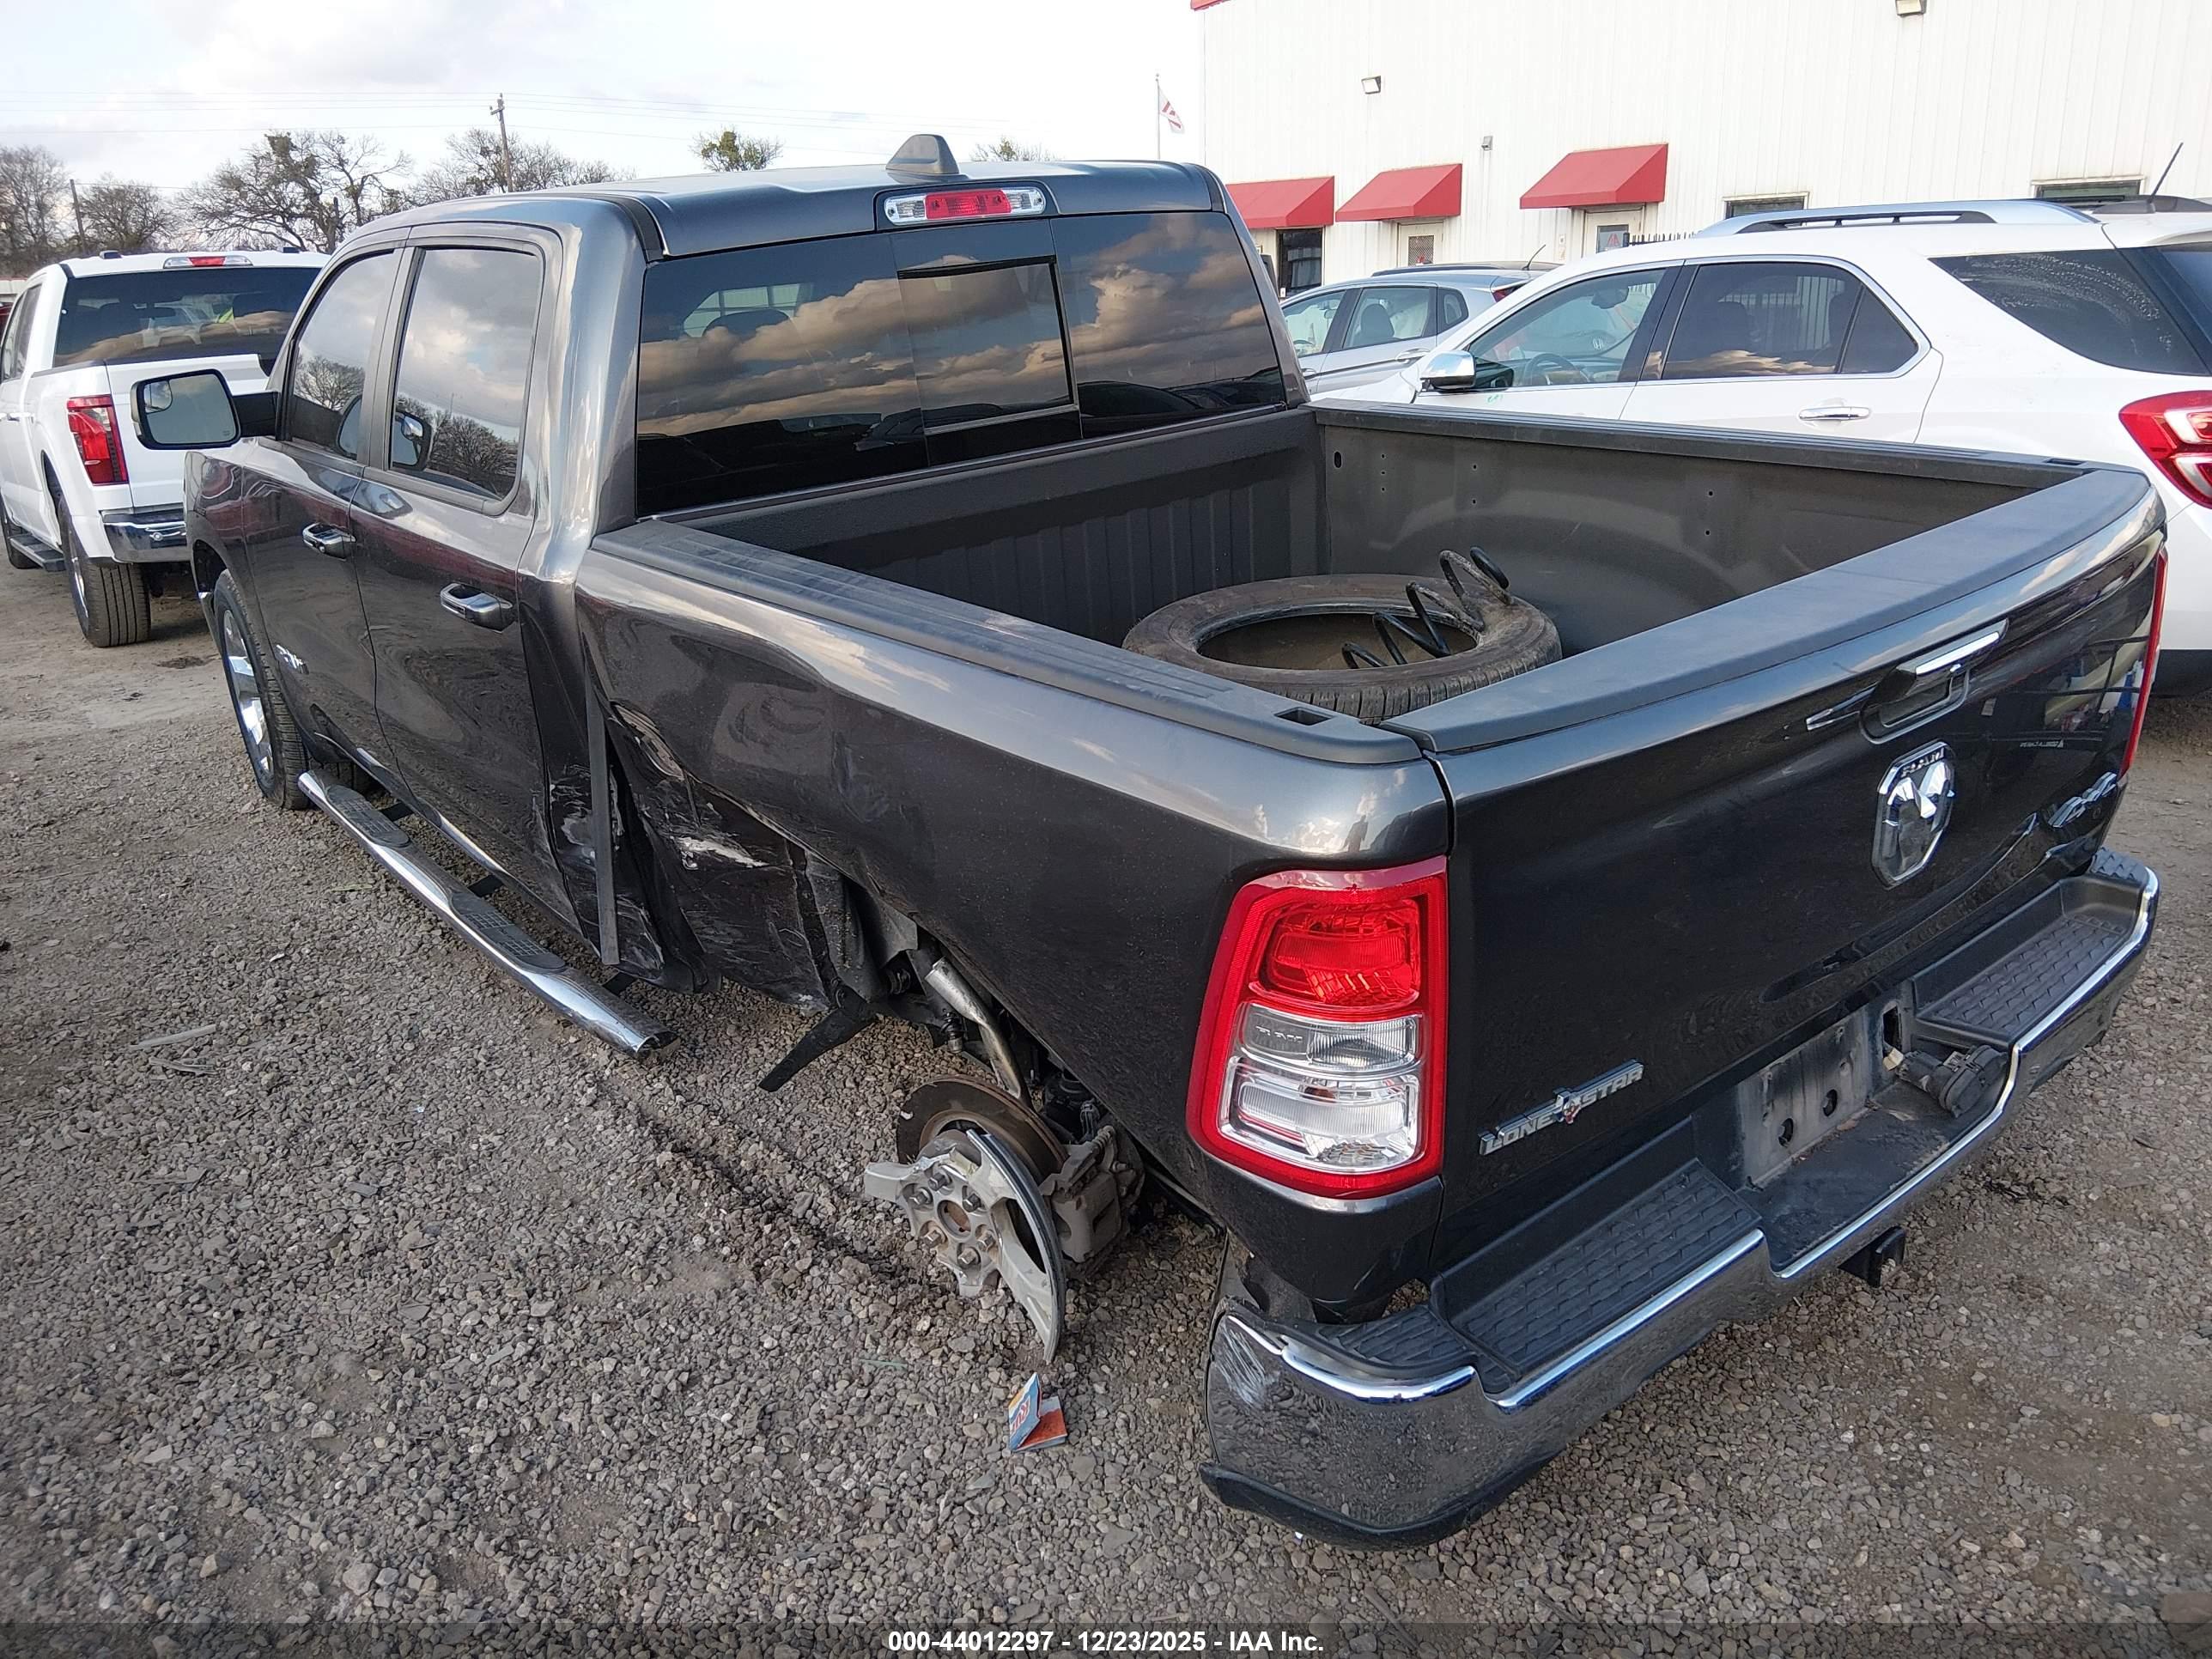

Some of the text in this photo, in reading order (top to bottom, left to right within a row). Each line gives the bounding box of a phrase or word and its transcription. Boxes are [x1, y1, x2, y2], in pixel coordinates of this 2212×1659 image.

[1900, 747, 1945, 779] RAM
[1478, 1061, 1644, 1157] LONE STAR
